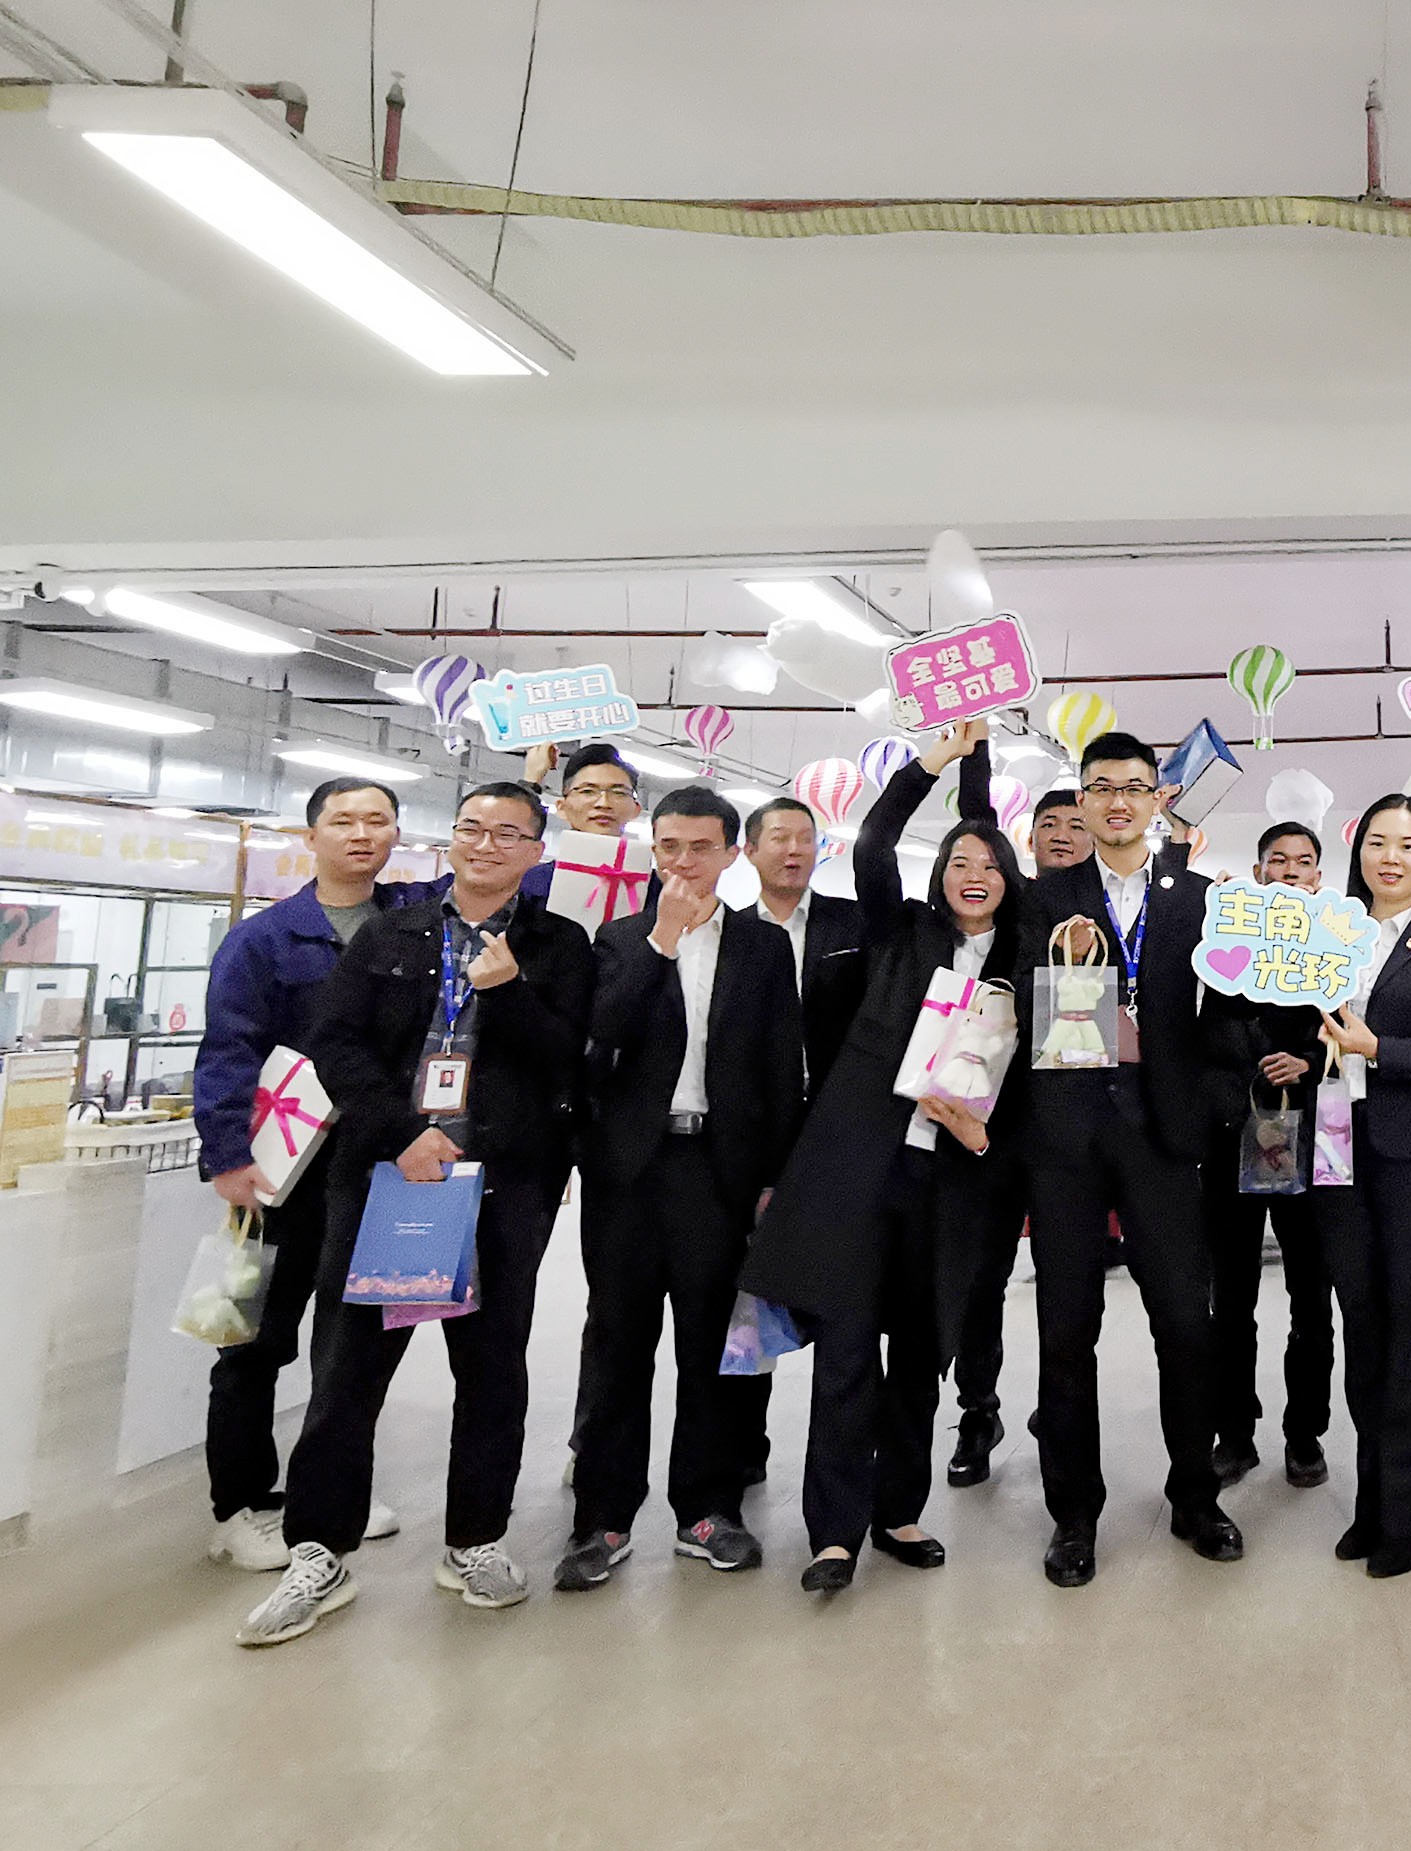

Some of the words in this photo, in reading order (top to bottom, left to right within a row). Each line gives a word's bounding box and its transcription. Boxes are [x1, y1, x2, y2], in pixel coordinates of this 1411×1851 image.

[524, 673, 607, 705] 过生日
[933, 662, 1019, 711] 最可爱
[518, 702, 630, 738] 就要开心
[1215, 888, 1311, 945] 主角
[1253, 945, 1352, 999] 光环
